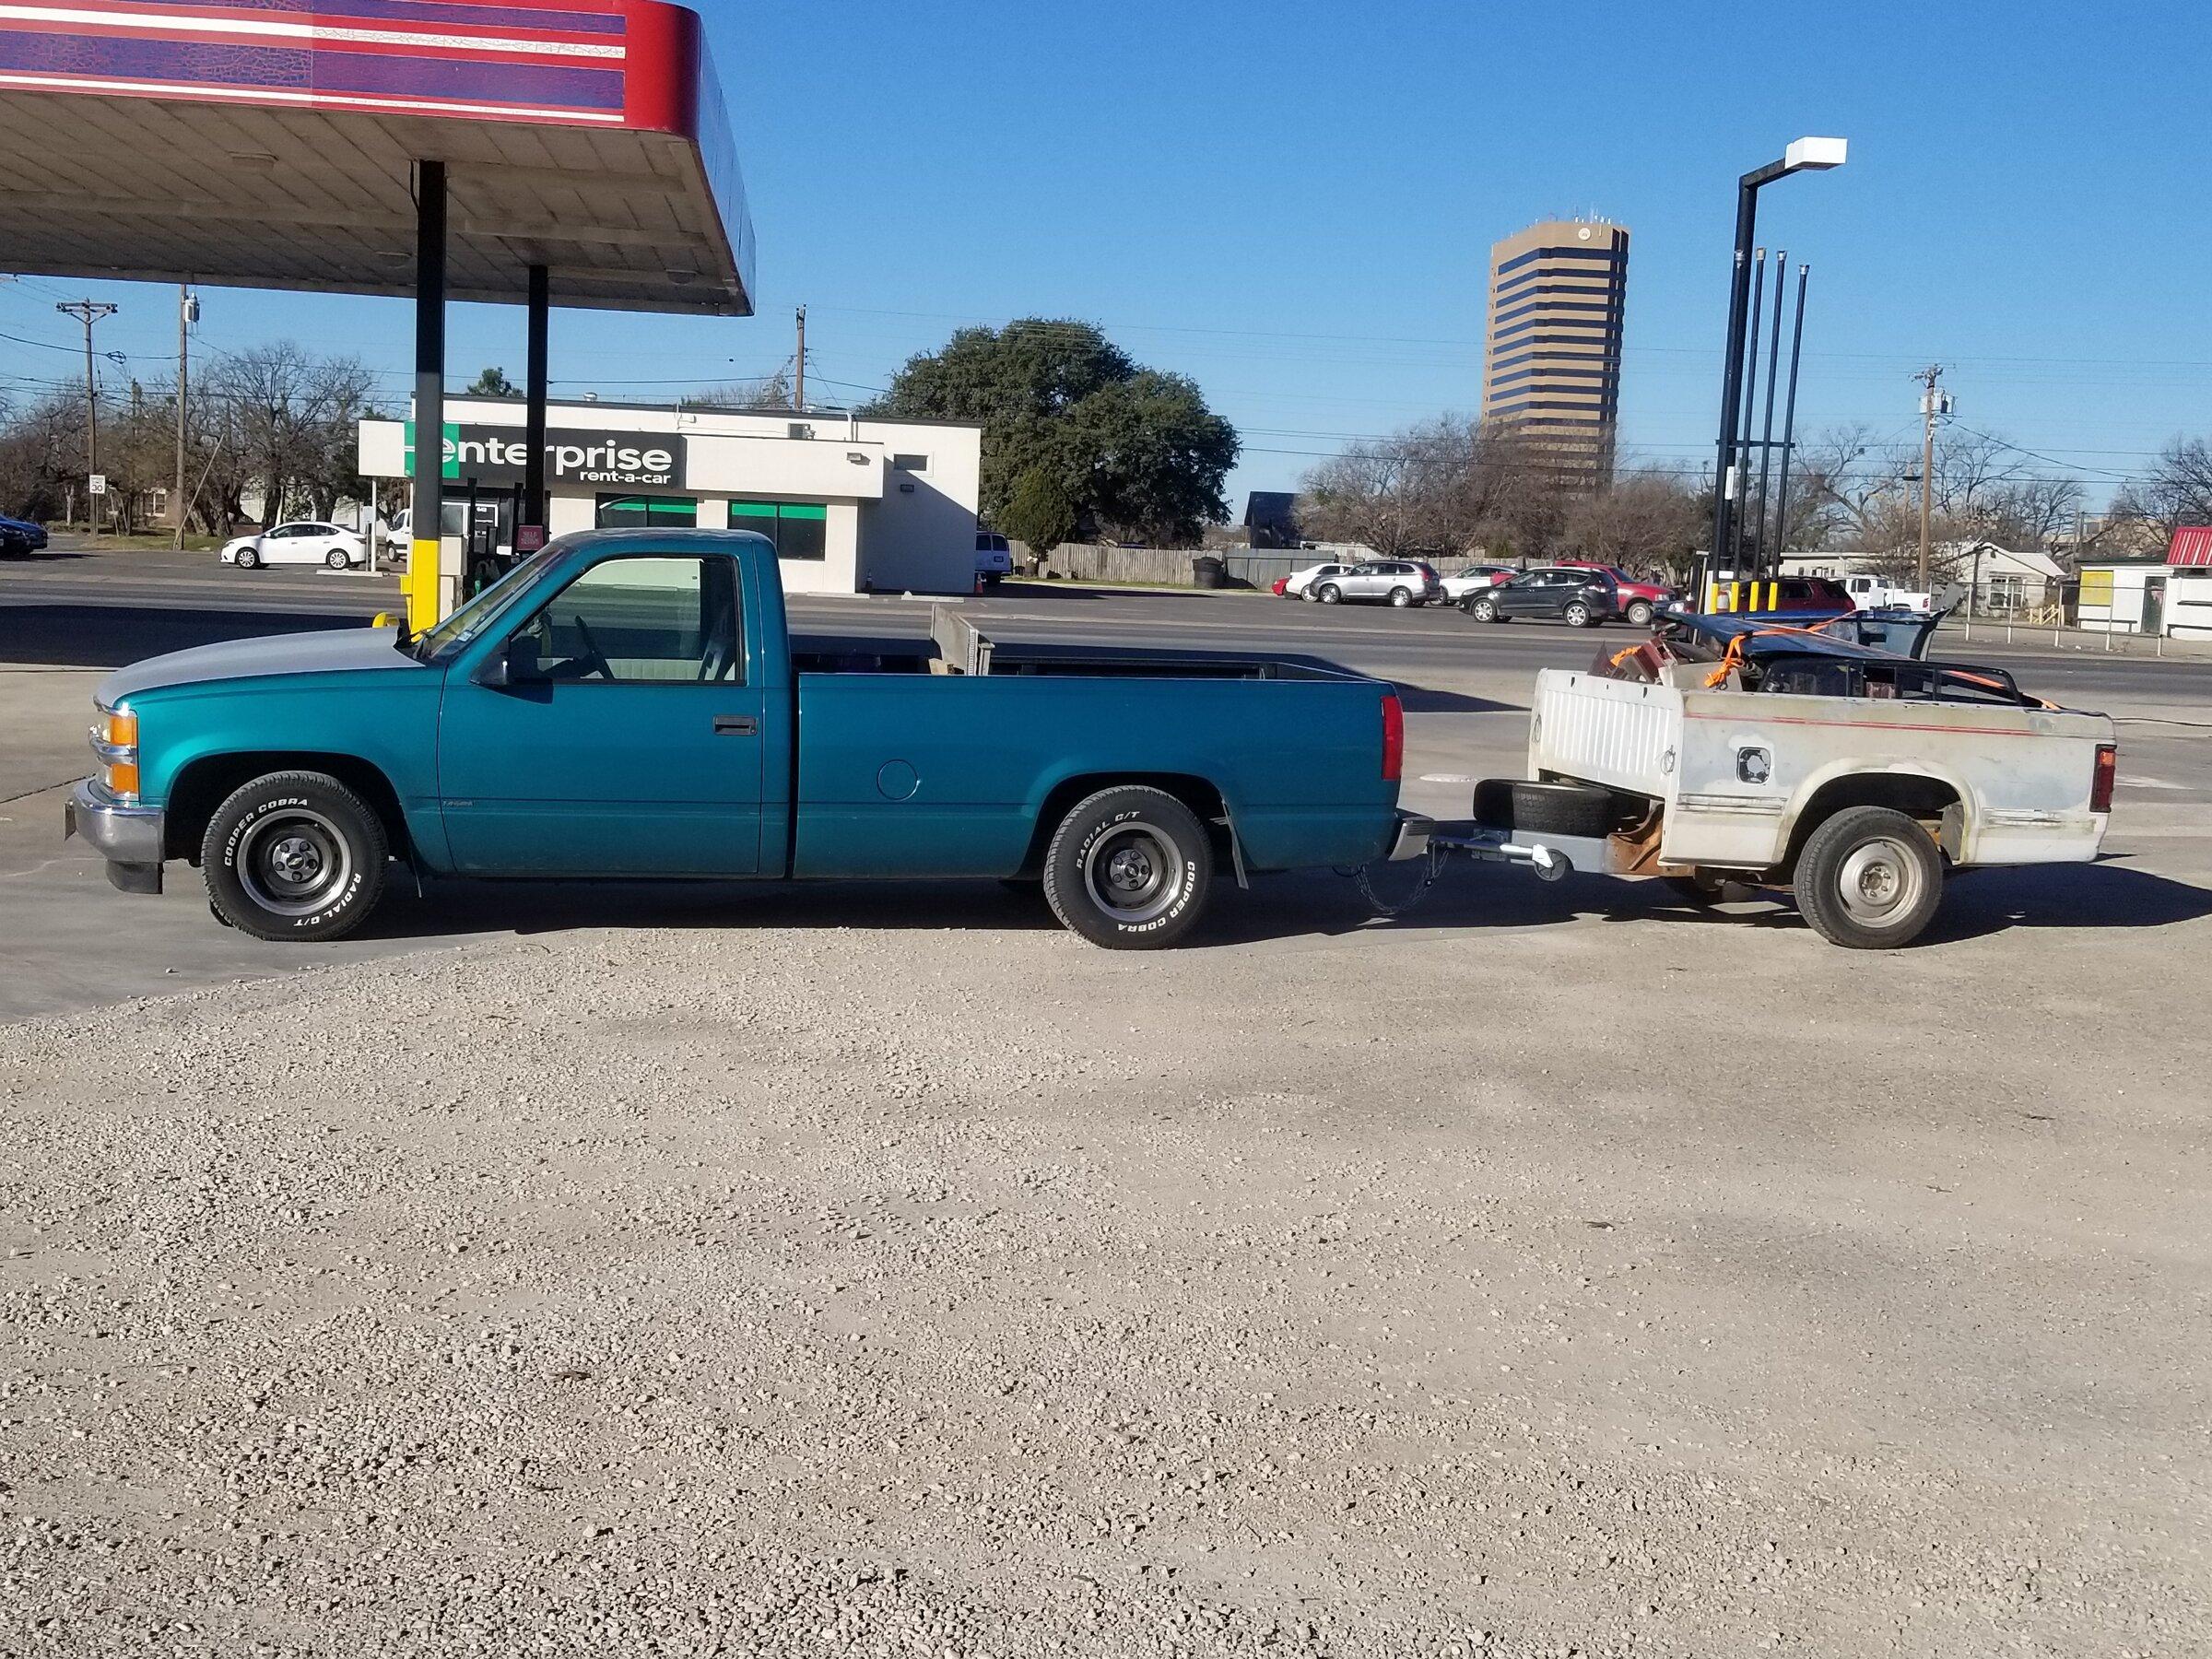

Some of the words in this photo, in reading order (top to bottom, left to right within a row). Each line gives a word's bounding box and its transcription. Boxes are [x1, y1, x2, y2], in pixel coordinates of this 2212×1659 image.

[91, 484, 103, 492] 30
[580, 471, 671, 484] rent-a-car
[224, 812, 254, 866] COOPER
[258, 798, 308, 814] COBRA
[1076, 821, 1111, 869] RADIAL
[324, 873, 362, 918] RADIAL
[1170, 861, 1195, 919] COOPER
[1118, 917, 1167, 933] COBRA
